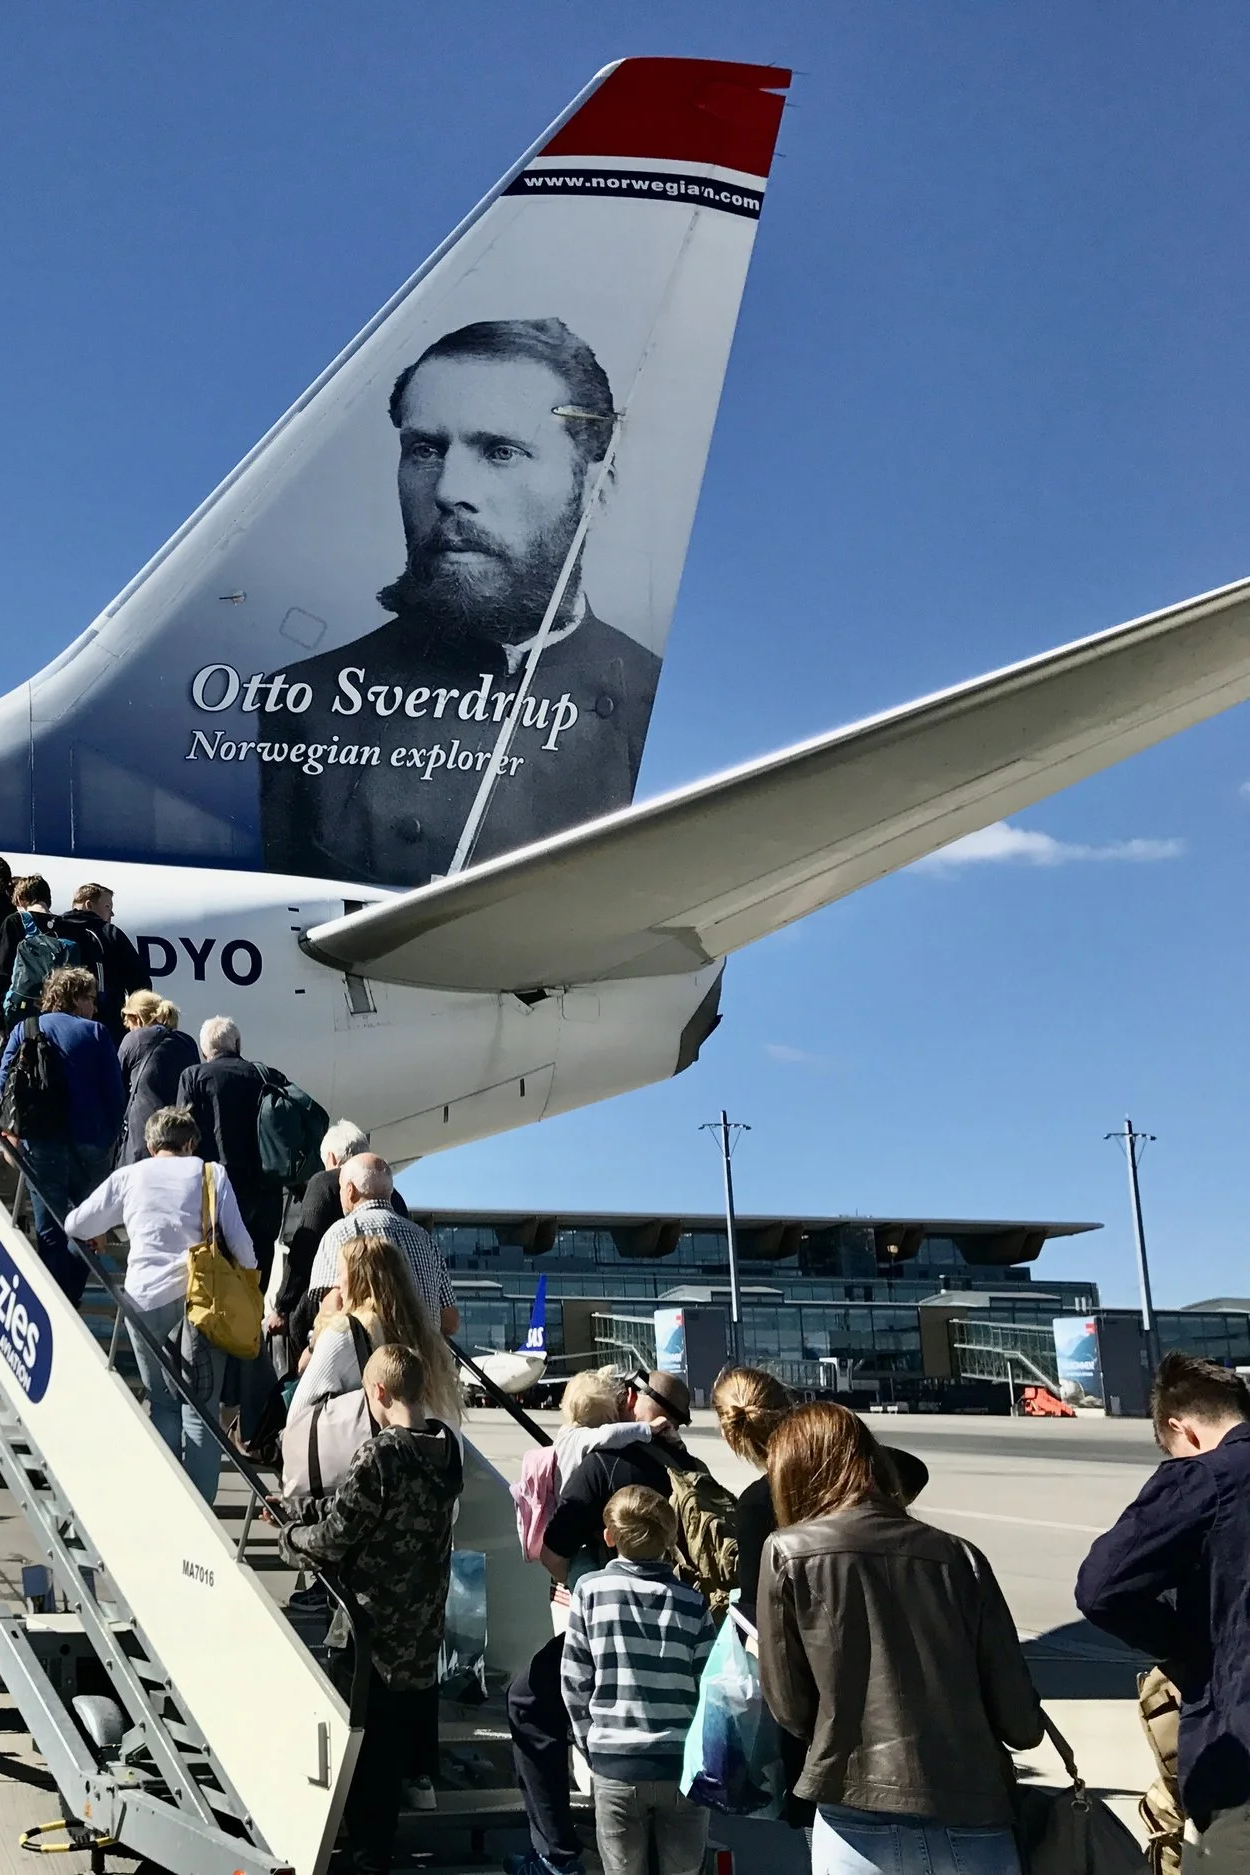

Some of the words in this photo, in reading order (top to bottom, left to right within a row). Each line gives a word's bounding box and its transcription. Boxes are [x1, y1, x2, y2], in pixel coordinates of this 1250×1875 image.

[523, 176, 760, 211] www.norwegian.com
[191, 663, 313, 713] Otto
[331, 667, 579, 751] Sverdrup
[185, 730, 381, 776] Norwegian
[390, 739, 524, 780] explorer
[525, 1326, 545, 1349] SAS
[182, 1559, 215, 1587] MA7016
